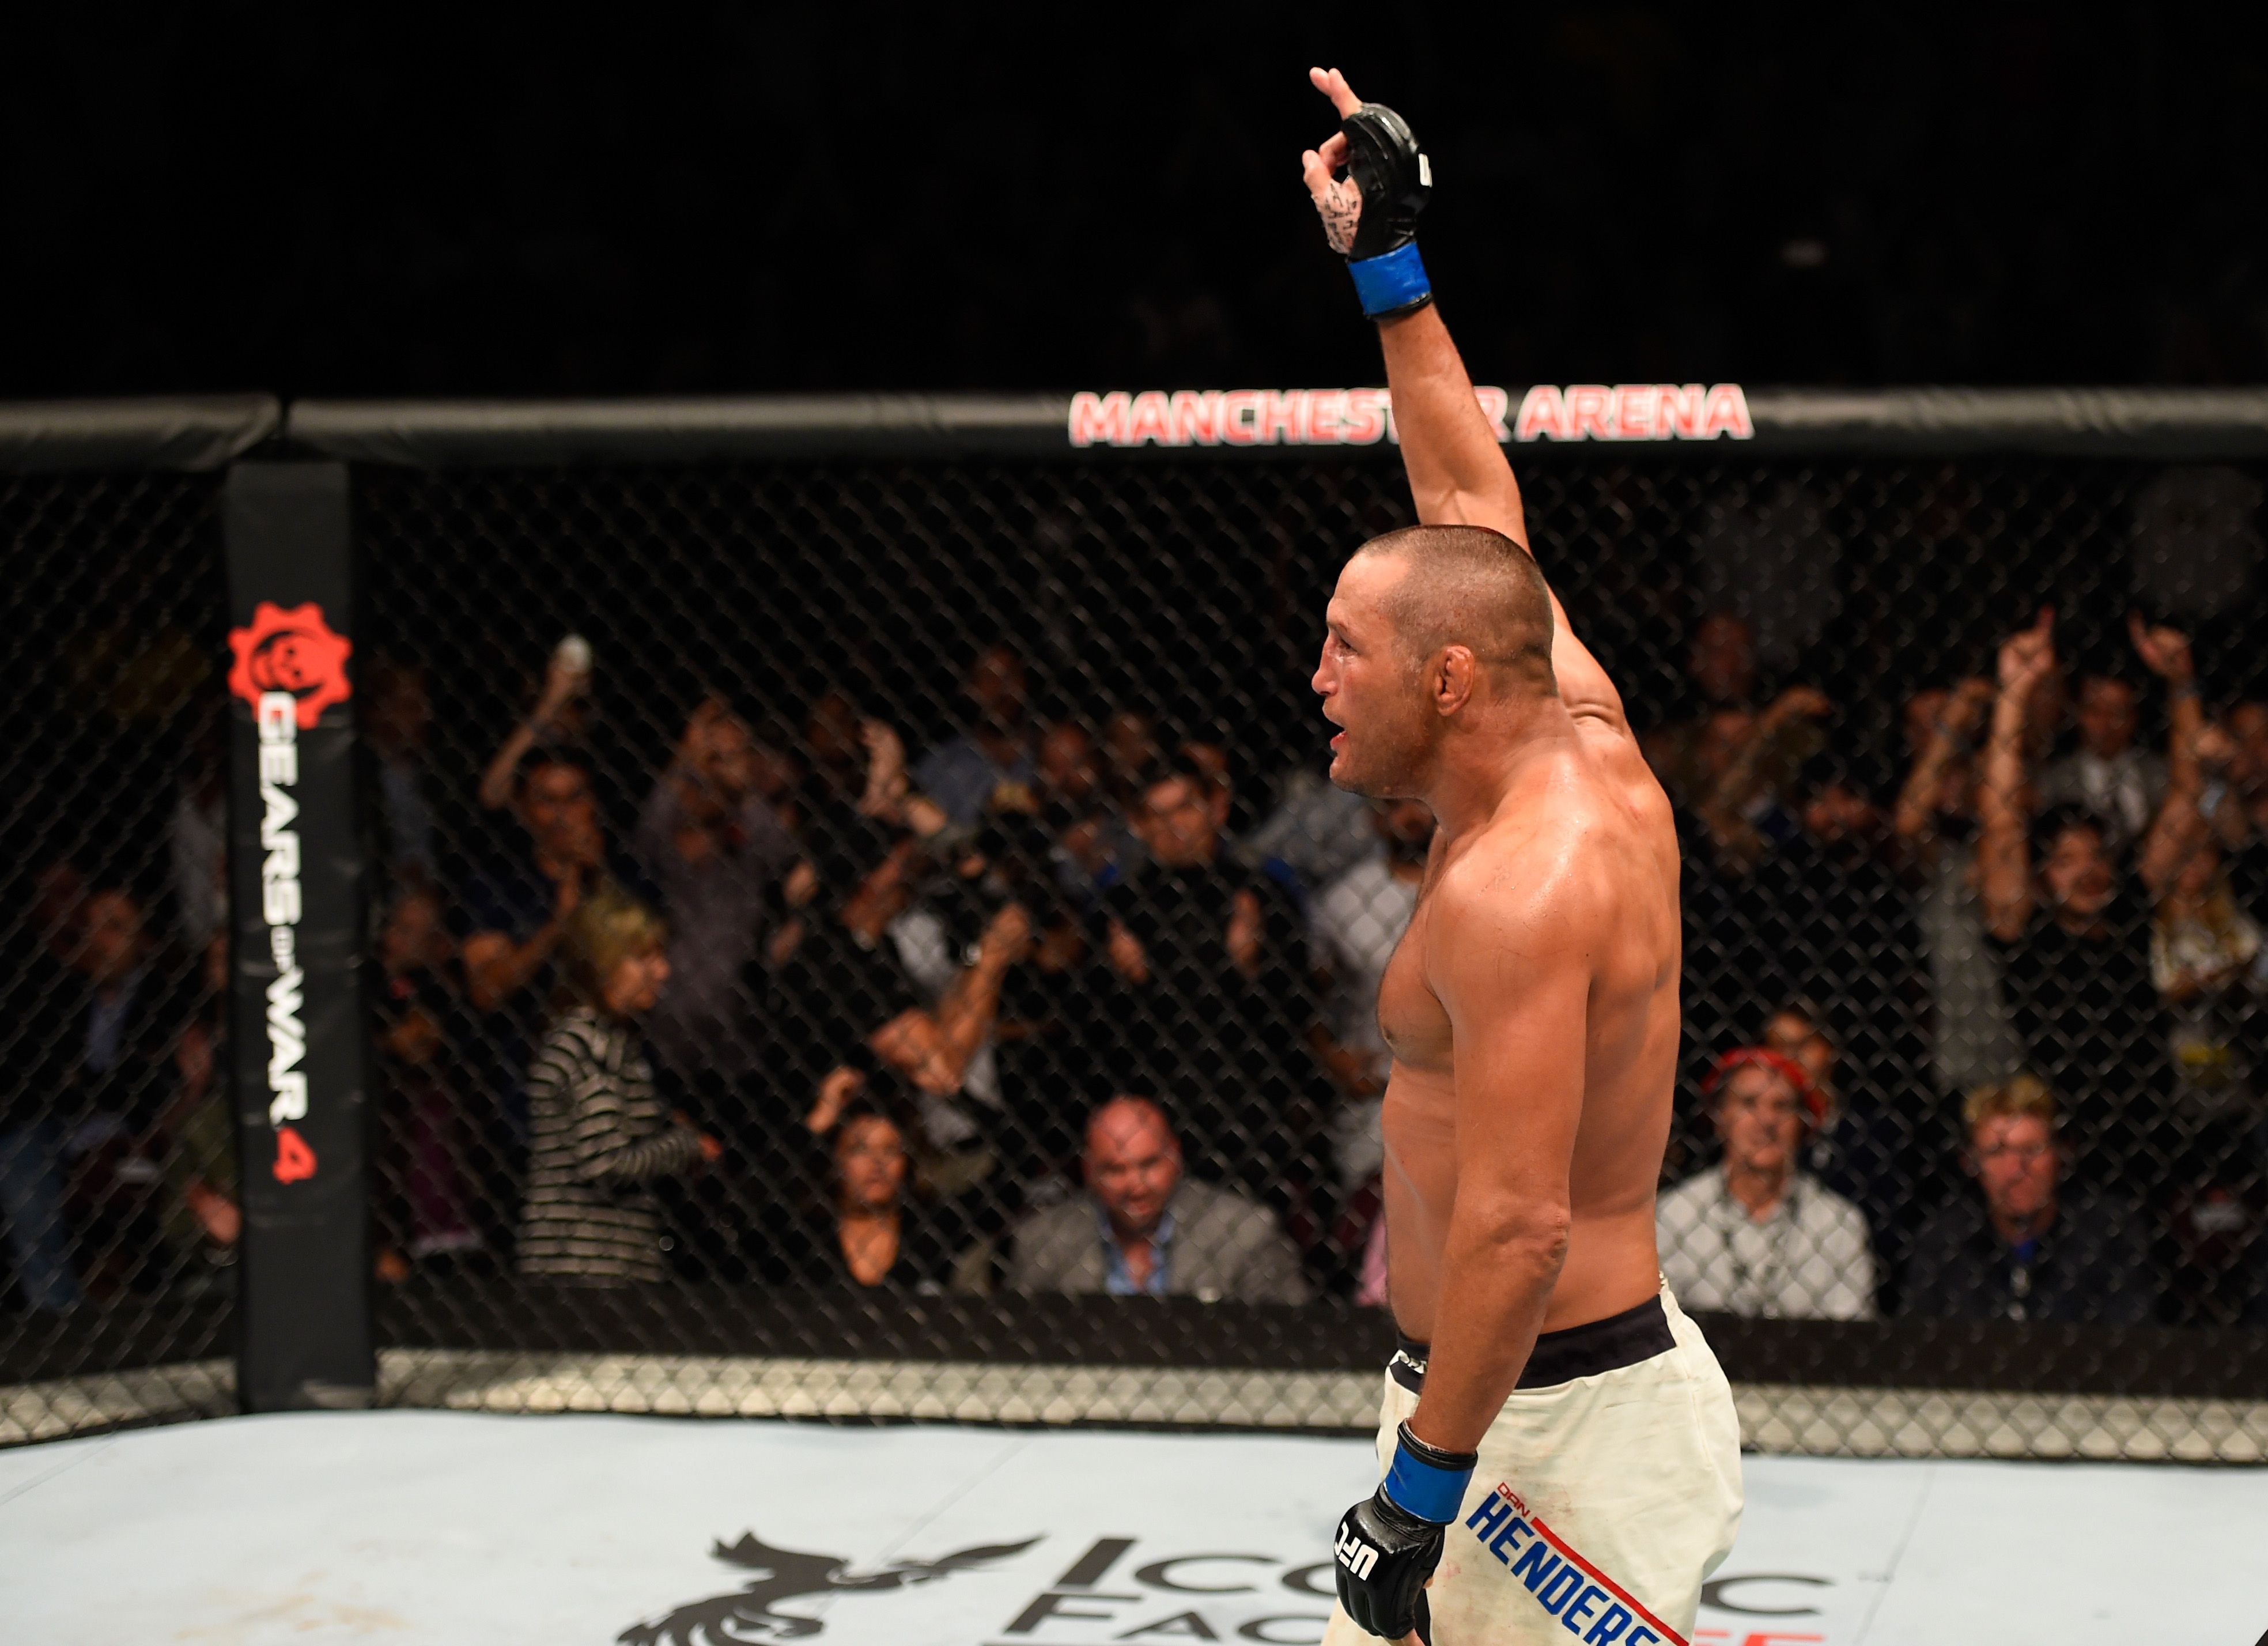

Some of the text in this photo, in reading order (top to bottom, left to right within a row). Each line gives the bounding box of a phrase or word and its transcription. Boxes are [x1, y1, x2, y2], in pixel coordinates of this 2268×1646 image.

[1069, 384, 1755, 446] MANCHESR ARENA
[258, 691, 302, 926] GEARS
[266, 966, 308, 1127] WAR
[272, 1125, 318, 1184] 4
[1335, 1521, 1379, 1581] UFC
